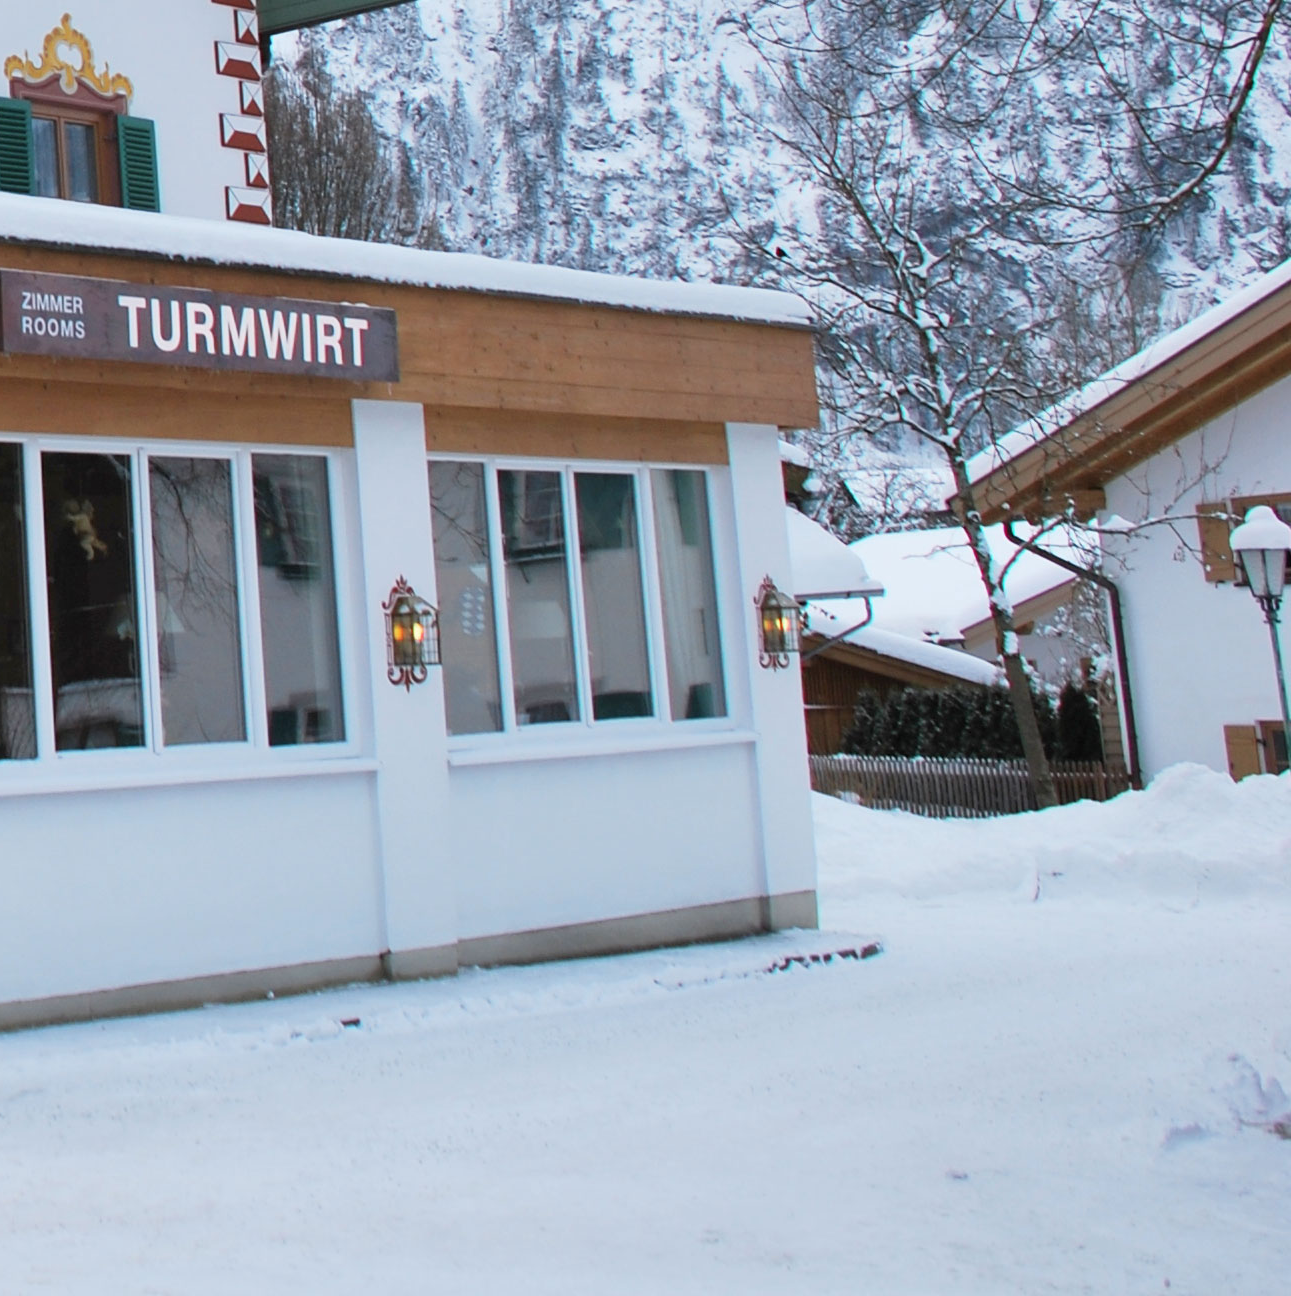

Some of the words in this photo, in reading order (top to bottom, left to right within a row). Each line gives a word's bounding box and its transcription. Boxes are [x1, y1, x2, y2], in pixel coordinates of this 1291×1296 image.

[21, 292, 84, 314] ZIMMER
[21, 316, 86, 339] ROOMS
[118, 294, 369, 366] TURMWIRT
